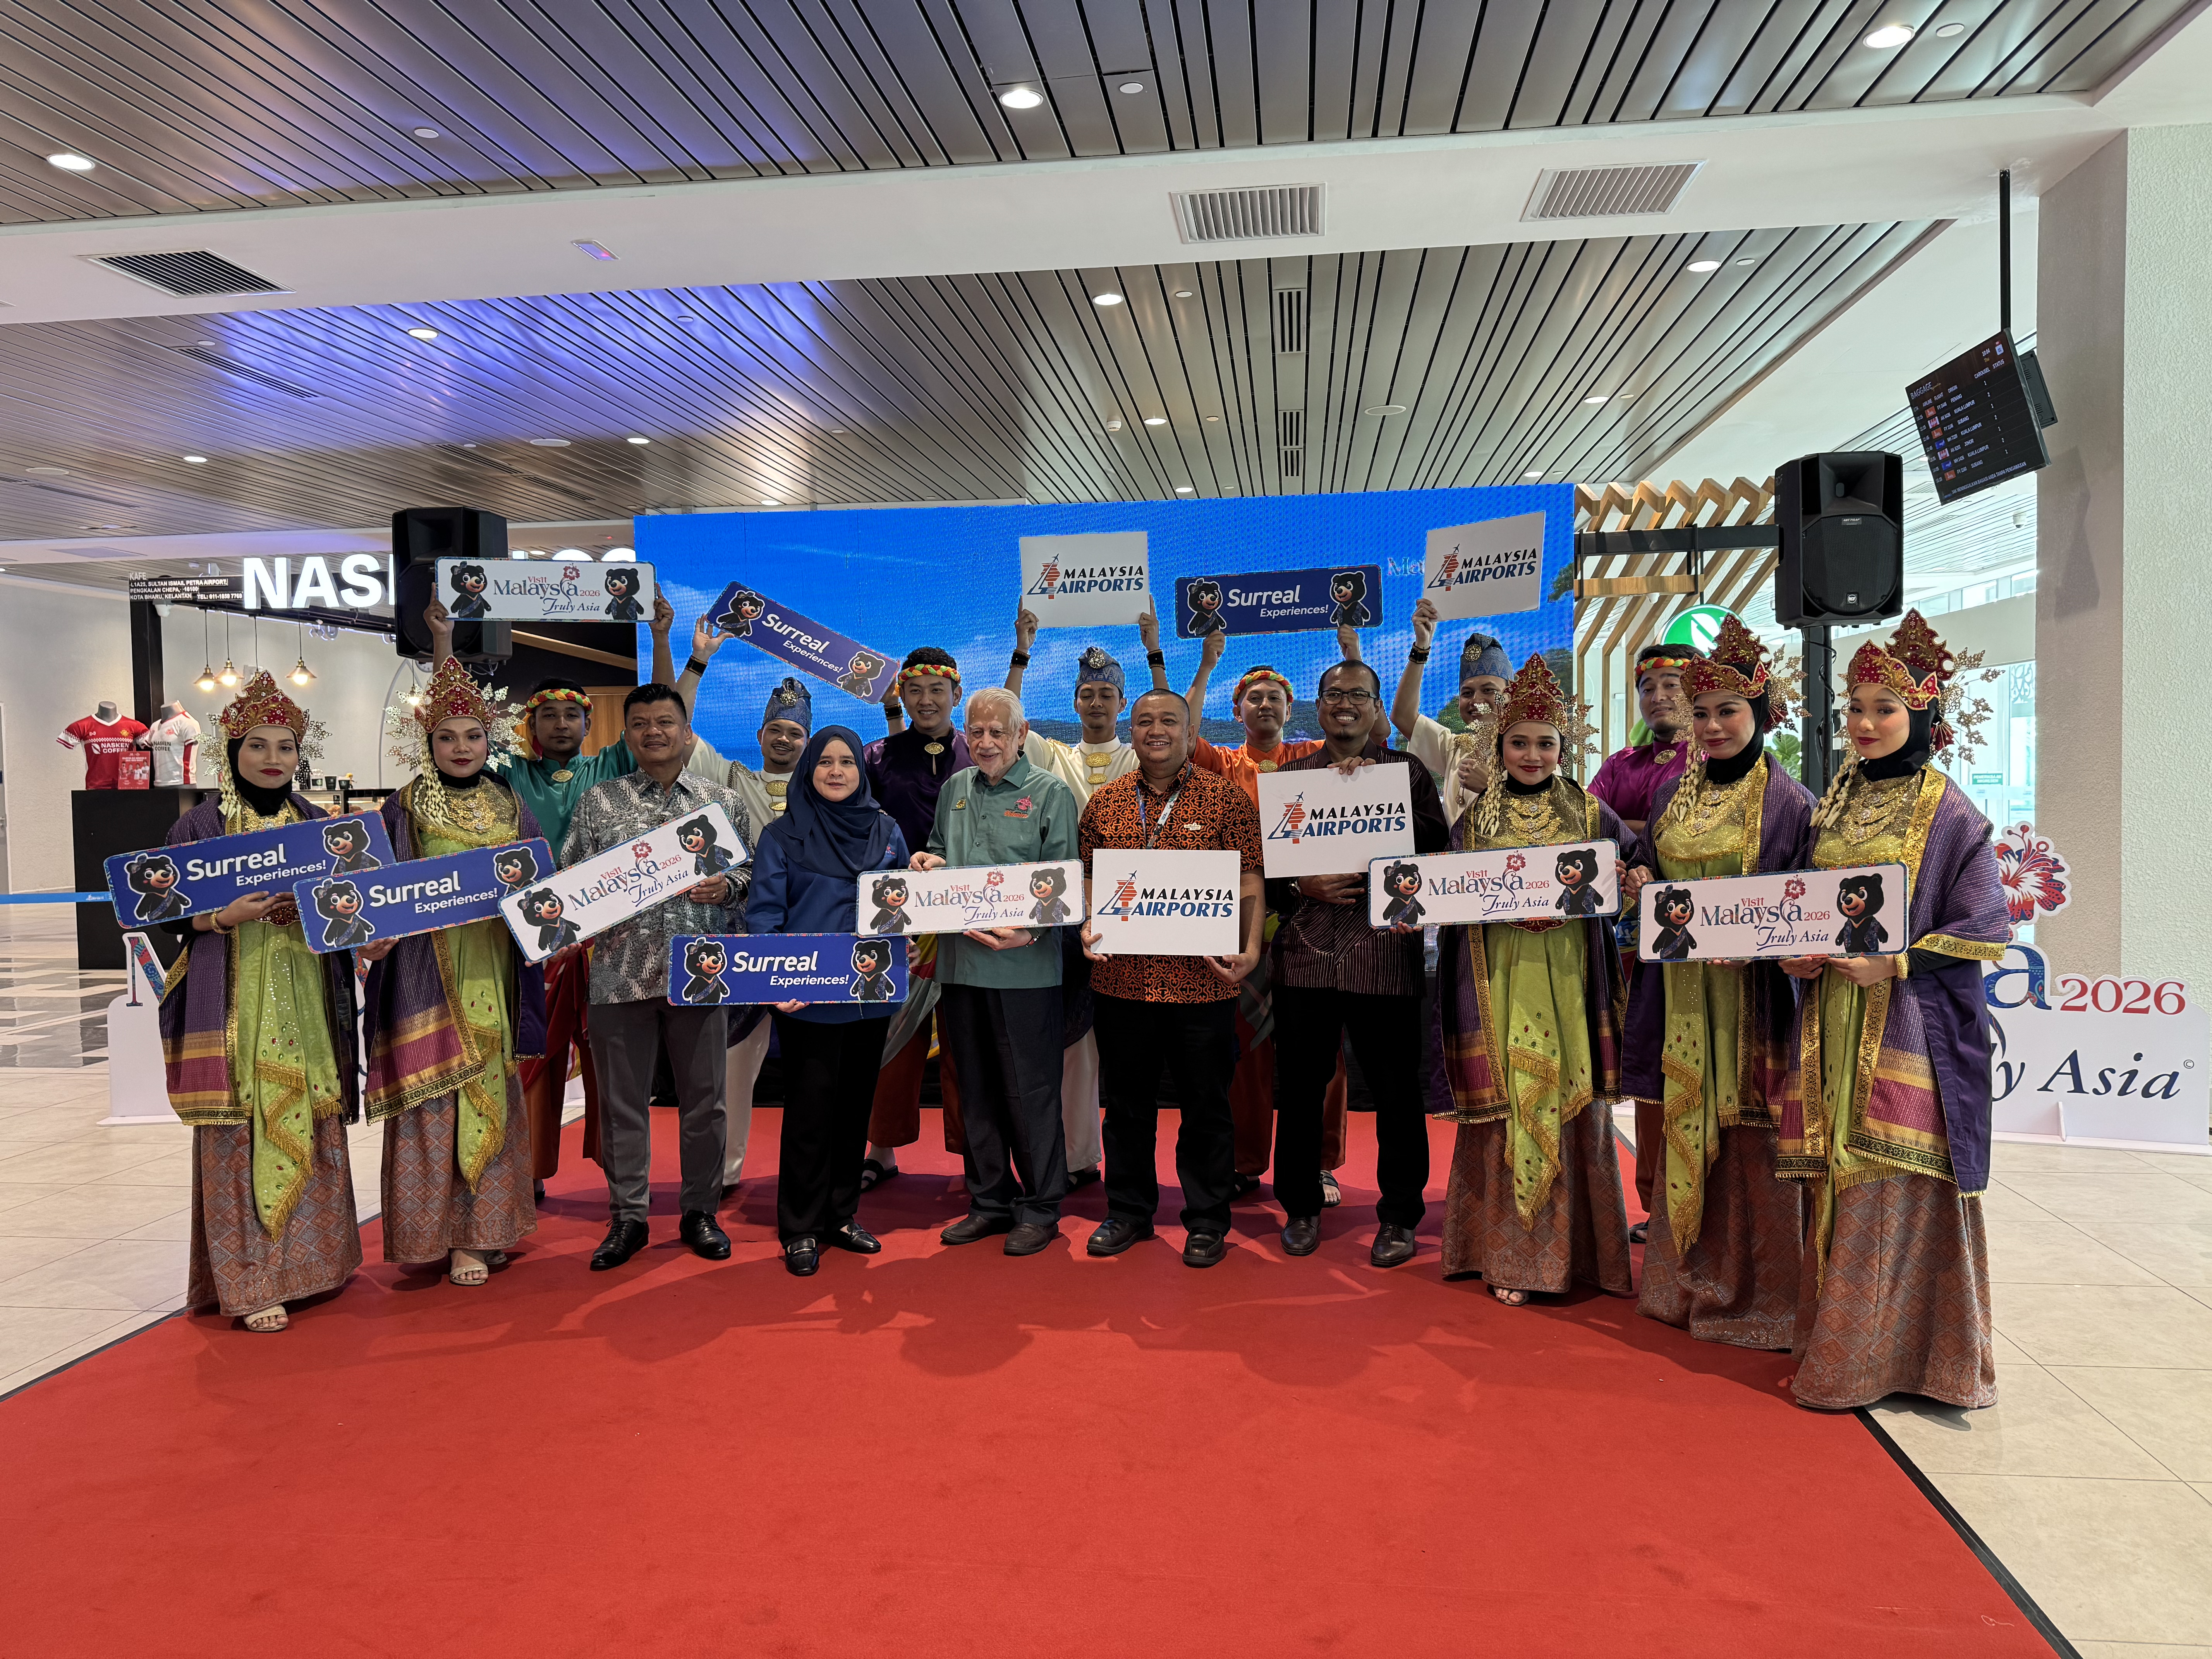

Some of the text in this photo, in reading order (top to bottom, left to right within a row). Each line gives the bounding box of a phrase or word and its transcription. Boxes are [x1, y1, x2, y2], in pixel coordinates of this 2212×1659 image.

[1975, 368, 1990, 378] CAROUSEL
[1993, 359, 2004, 369] STATUS
[1910, 382, 1933, 399] BAGGAGE
[1462, 548, 1537, 569] MALAYSIA
[129, 572, 146, 580] KAFE
[244, 554, 395, 609] NAS
[1064, 566, 1144, 579] MALAYSIA
[1453, 561, 1536, 585] AIRPORTS
[1056, 578, 1144, 594] AIRPORTS
[1227, 585, 1300, 607] Surreal
[543, 598, 600, 613] Truly Asia
[1260, 605, 1329, 619] Experiences!
[762, 614, 830, 653] Surreal
[783, 640, 843, 673] Experiences!
[1310, 802, 1405, 820] MALAYSIA
[1302, 816, 1406, 837] AIRPORTS
[187, 843, 287, 881] Surreal
[659, 854, 682, 869] 2026
[236, 860, 326, 886] Experiences!
[600, 867, 622, 880] Visit
[1466, 870, 1487, 878] Visit
[369, 871, 461, 907] Surreal
[629, 870, 689, 903] Truly Asia
[1525, 880, 1549, 890] 2026
[415, 888, 498, 913] Experiences!
[1141, 888, 1233, 901] MALAYSIA
[1482, 895, 1549, 911] Truly Asia
[1741, 897, 1764, 907] Visit
[964, 907, 1024, 921] Truly Asia
[1131, 902, 1233, 917] AIRPORTS
[1804, 911, 1830, 921] 2026
[1756, 926, 1829, 946] Truly Asia
[732, 951, 818, 972] Surreal
[770, 974, 849, 988] Experiences!
[2060, 978, 2186, 1015] 2026
[2037, 1049, 2180, 1099] Asia
